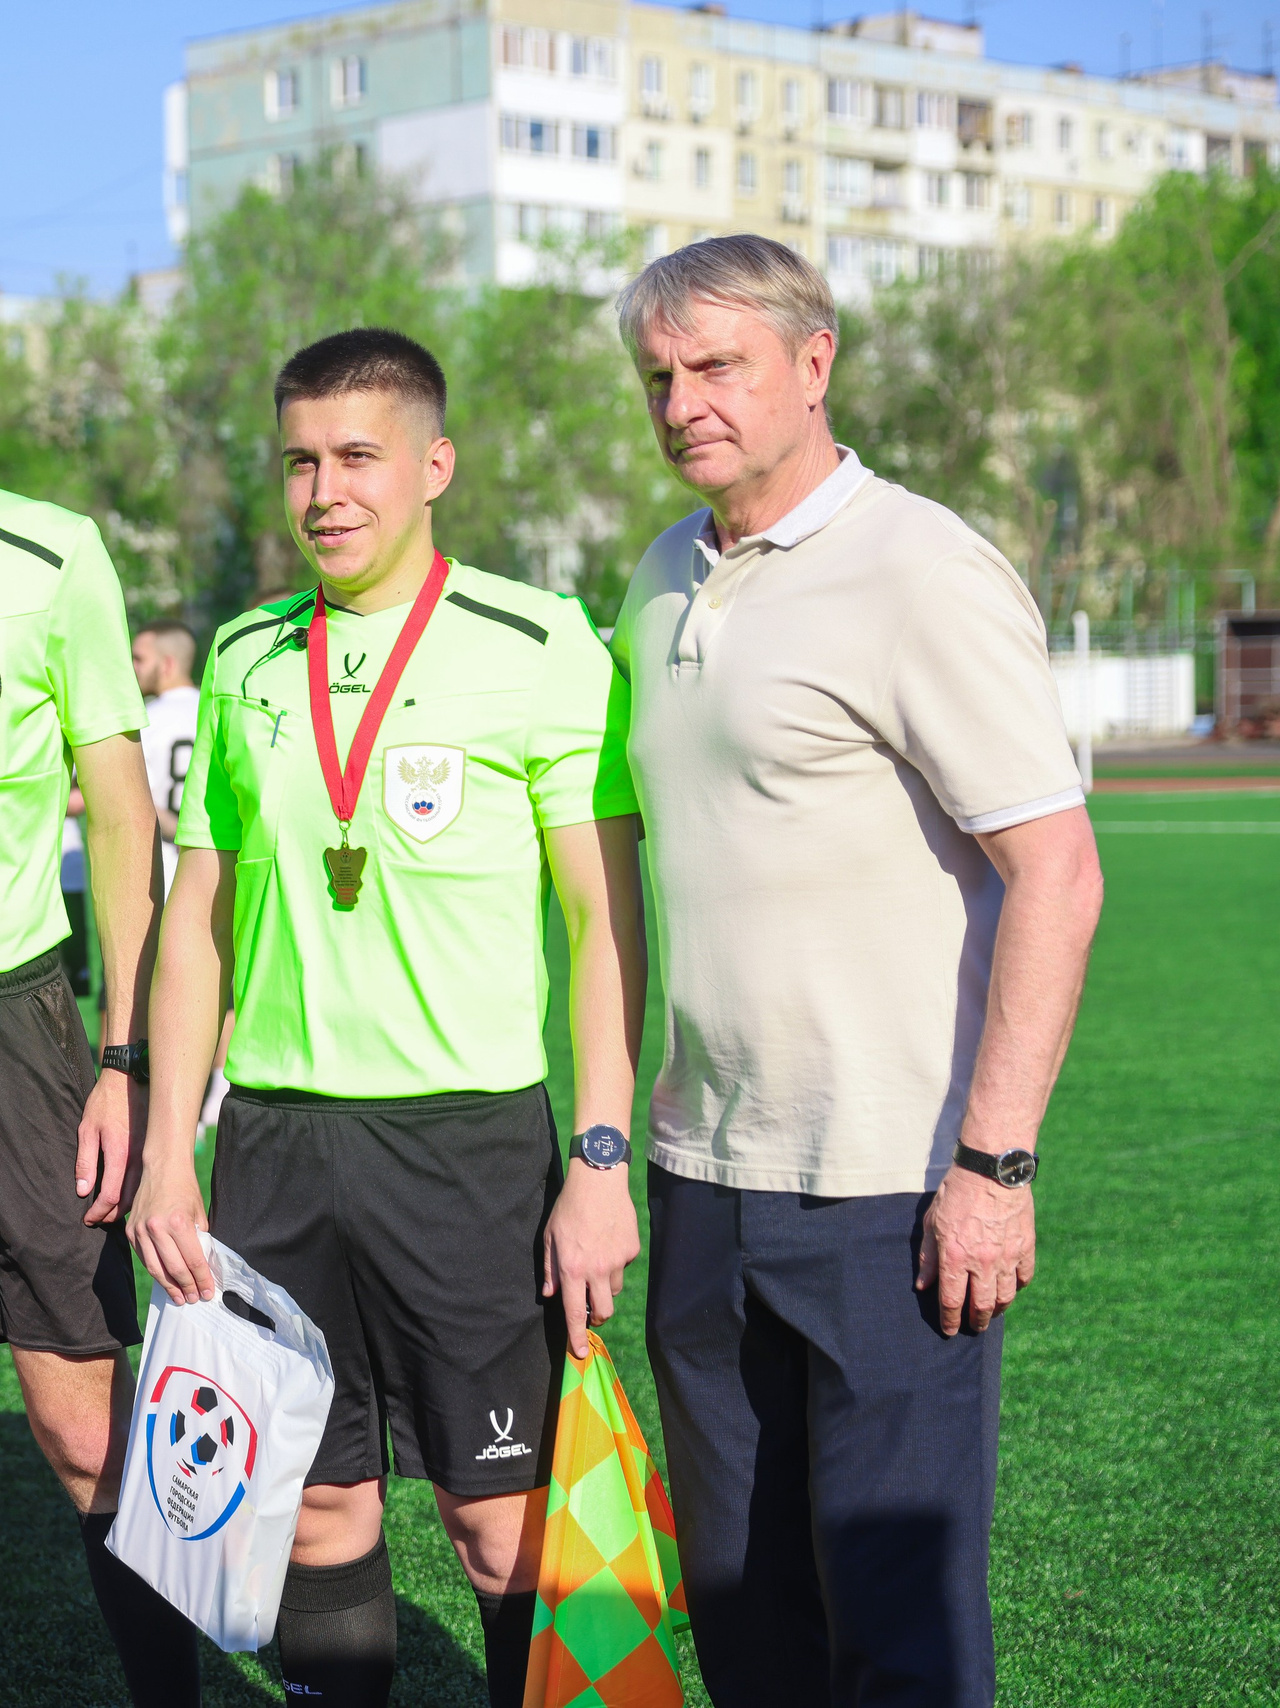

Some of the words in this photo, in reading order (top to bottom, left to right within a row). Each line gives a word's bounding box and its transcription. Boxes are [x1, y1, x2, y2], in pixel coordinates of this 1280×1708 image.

[329, 682, 371, 693] ÖGEL
[475, 1442, 532, 1460] JÖGEL
[169, 1485, 196, 1512] ГОРОДСКАЯ
[171, 1474, 199, 1501] САМАРСКАЯ
[166, 1497, 195, 1524] ФЕДЕРАЦИЯ
[167, 1510, 189, 1532] ФУТБОЛА
[282, 1678, 323, 1695] GEL
